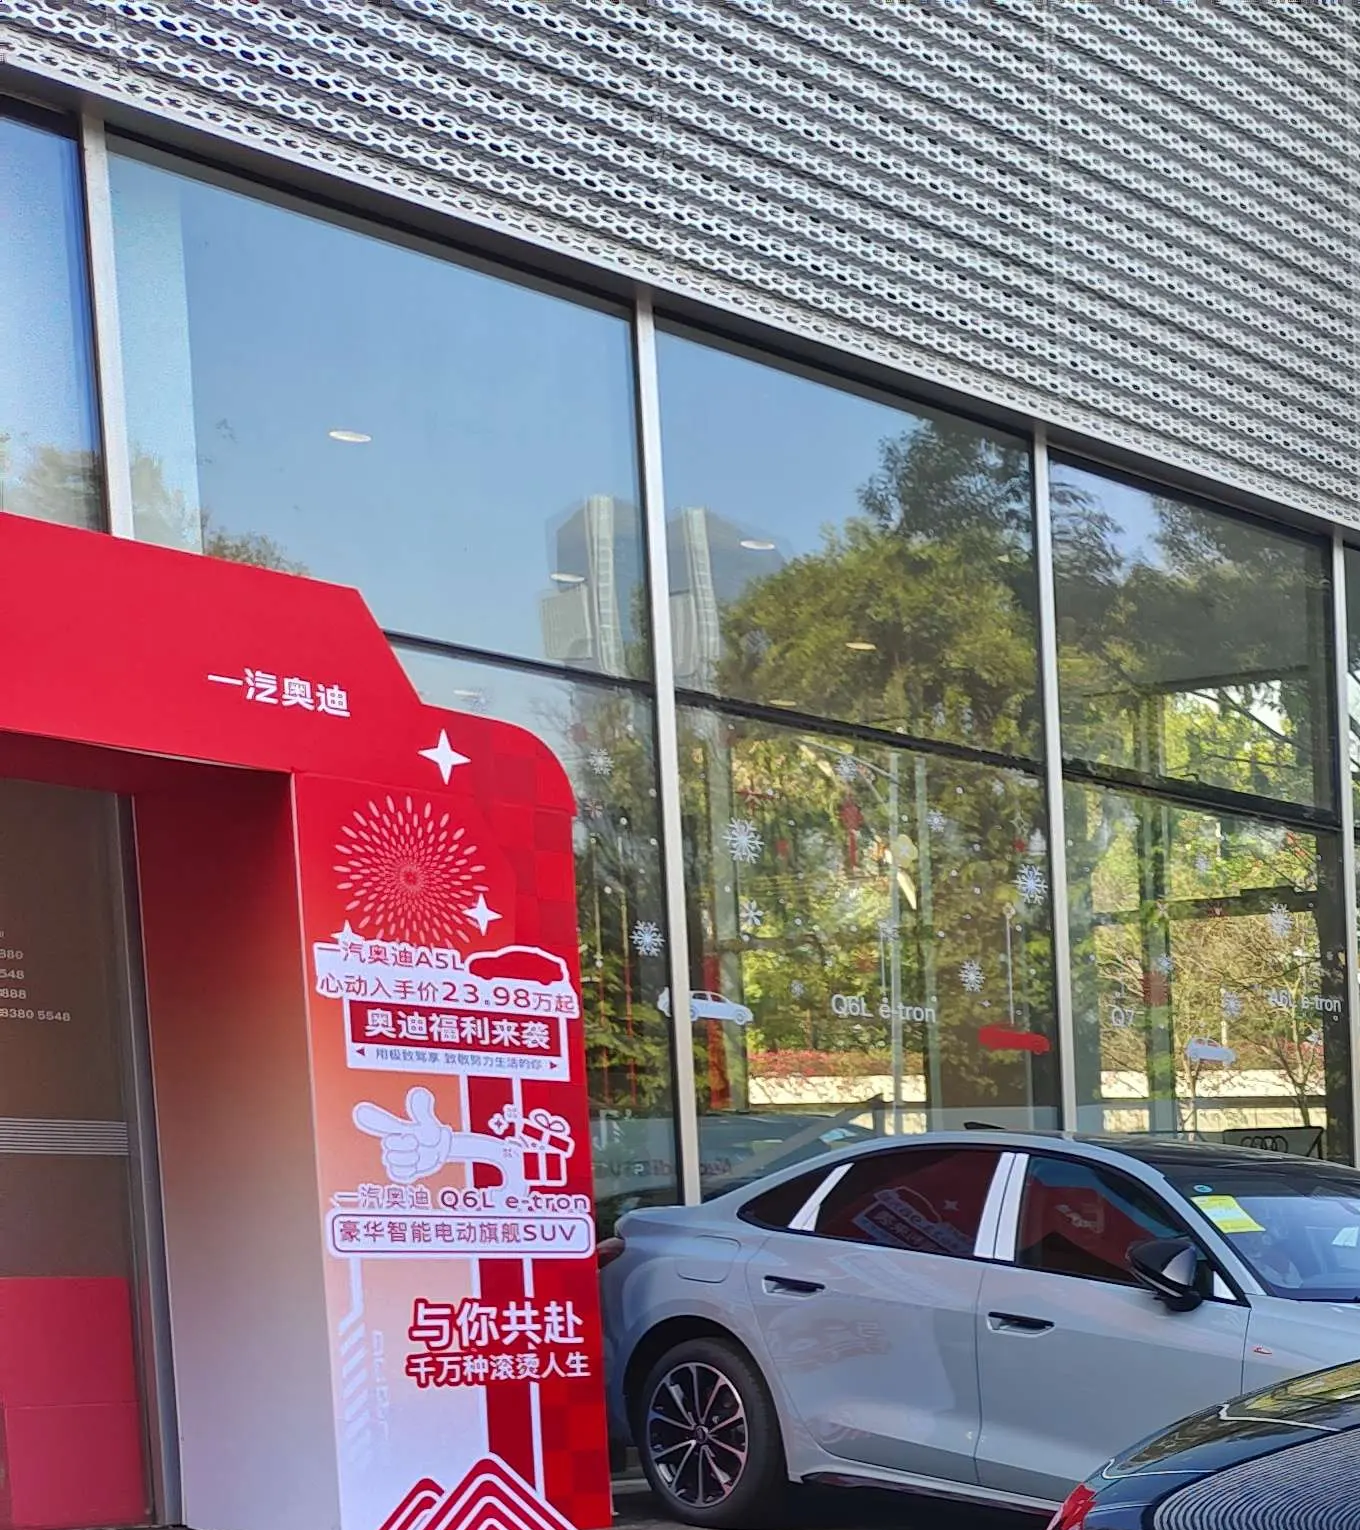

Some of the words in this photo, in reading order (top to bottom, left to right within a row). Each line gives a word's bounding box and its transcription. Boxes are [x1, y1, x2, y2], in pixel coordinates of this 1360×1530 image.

[207, 668, 350, 717] 一汽奥迪
[317, 940, 464, 972] 一汽奥迪A5L
[320, 973, 575, 1014] 心动入手价23.98万起
[831, 993, 873, 1018] Q6L
[364, 1008, 550, 1049] 奥迪福利来袭
[337, 1184, 430, 1209] 一汽奥迪
[440, 1190, 496, 1209] Q6L
[504, 1192, 588, 1211] e-tron
[339, 1219, 577, 1244] 豪华智能电动旗舰SUV
[411, 1301, 584, 1348] 与你共赴
[408, 1351, 592, 1384] 千万种滚烫人生
